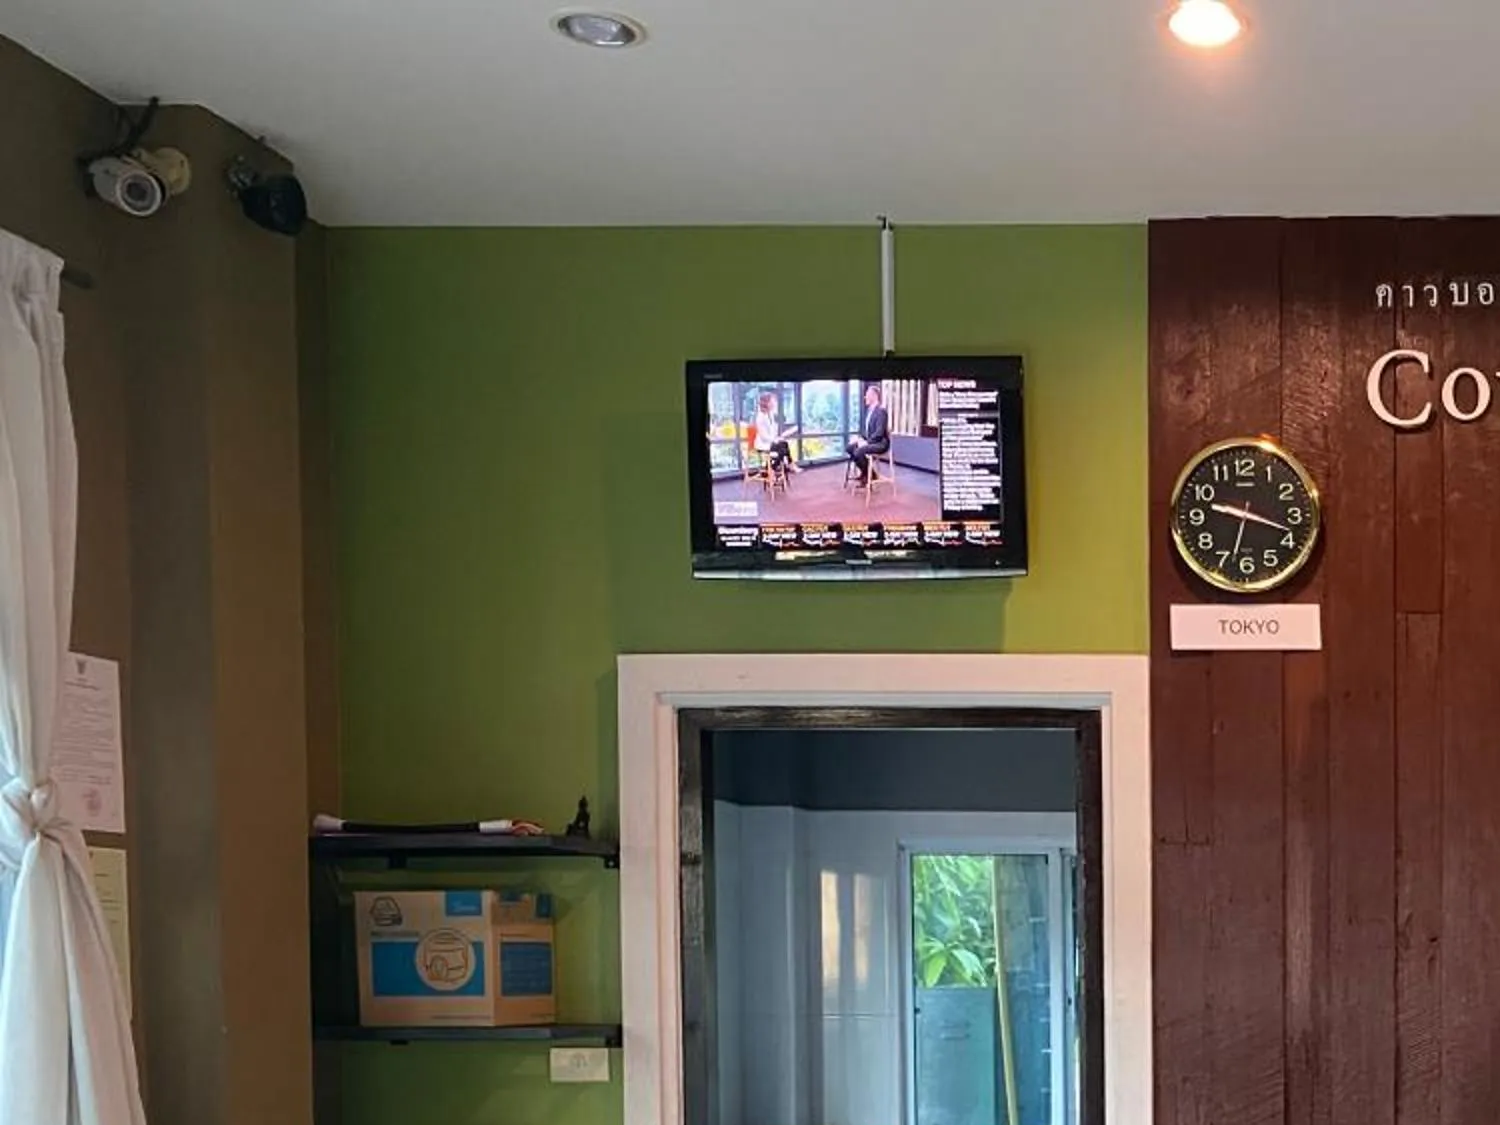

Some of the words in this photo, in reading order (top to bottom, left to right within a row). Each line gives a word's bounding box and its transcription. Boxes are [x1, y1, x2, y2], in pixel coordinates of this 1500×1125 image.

[1213, 465, 1229, 481] 11
[1235, 459, 1255, 477] 12
[1195, 485, 1215, 501] 10
[1279, 485, 1294, 500] 2
[1189, 509, 1205, 526] 9
[1287, 507, 1302, 524] 3
[1198, 533, 1213, 549] 8
[1280, 532, 1295, 549] 4
[1216, 551, 1231, 568] 7
[1240, 557, 1255, 574] 6
[1263, 550, 1279, 567] 5
[1218, 620, 1279, 634] TOKYO
